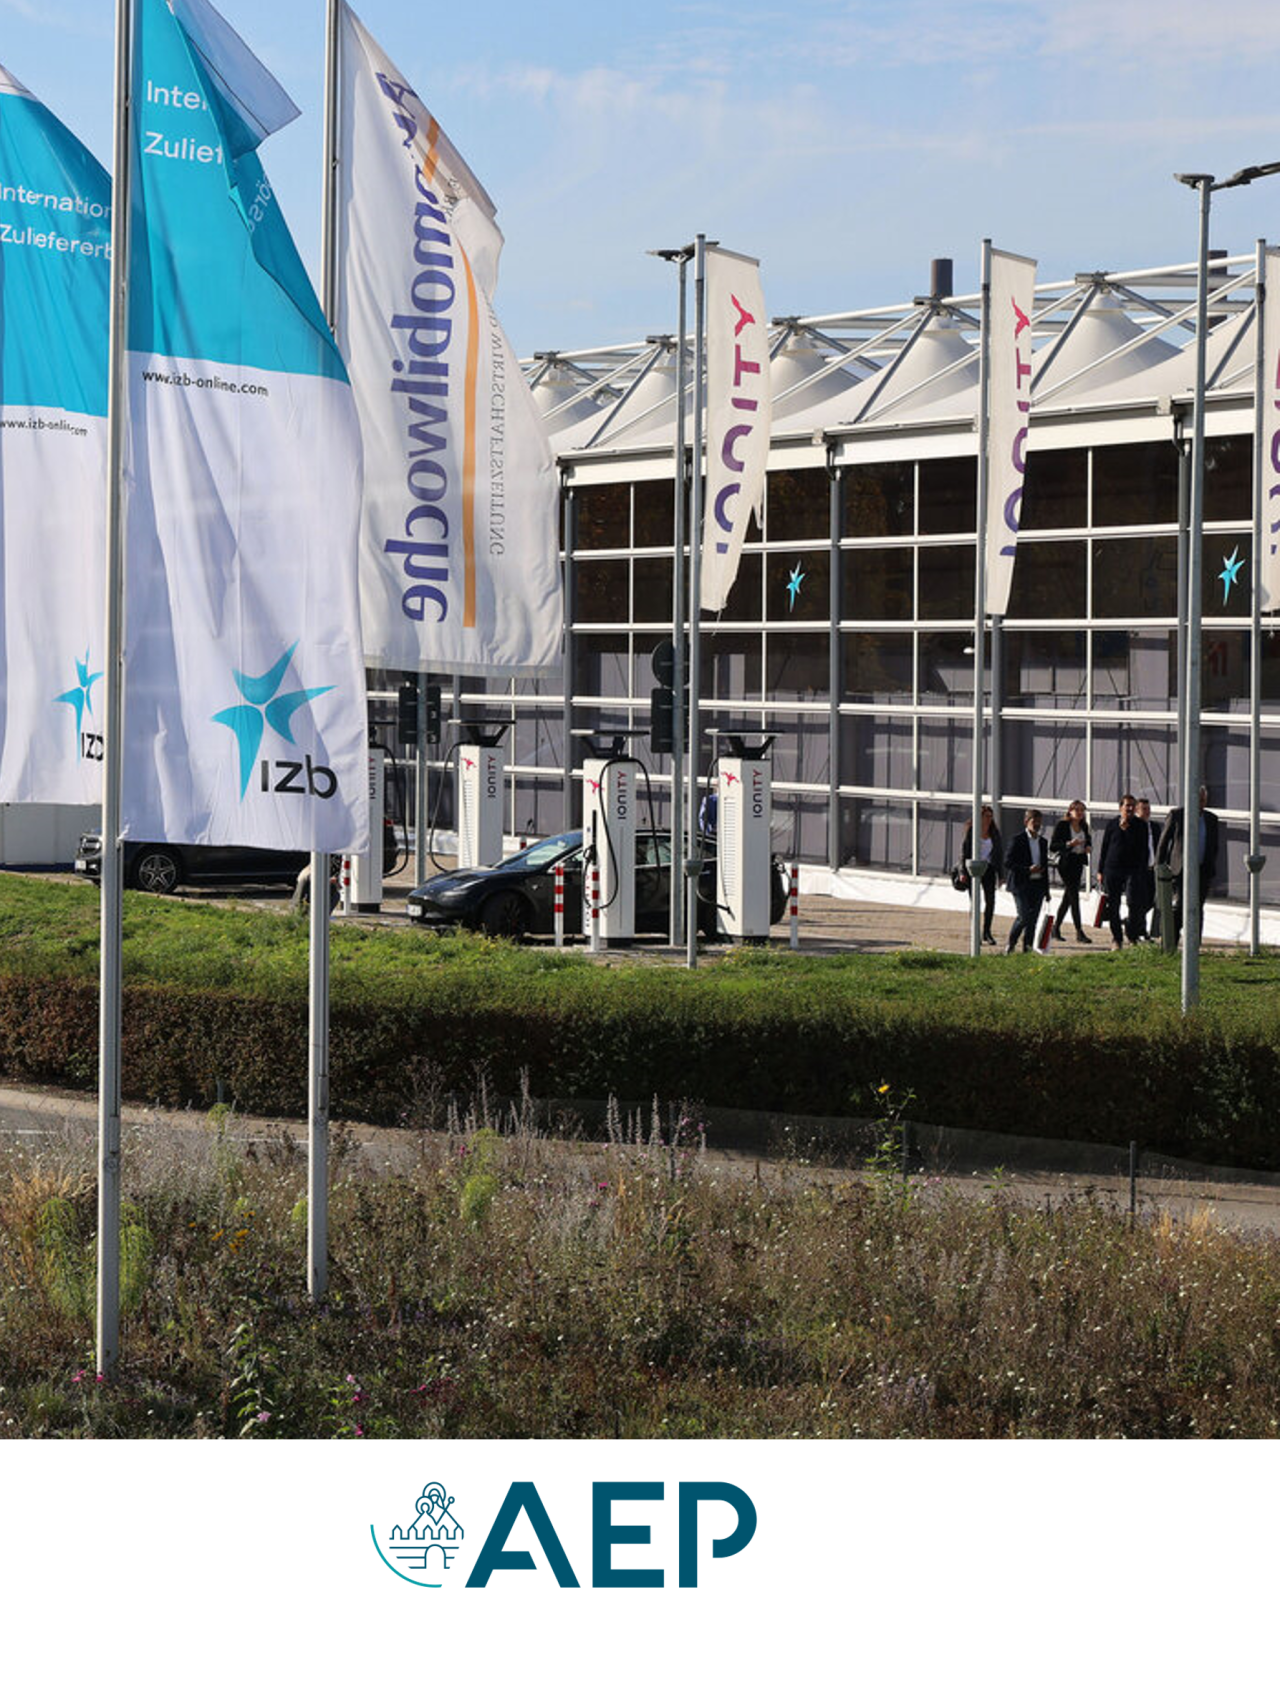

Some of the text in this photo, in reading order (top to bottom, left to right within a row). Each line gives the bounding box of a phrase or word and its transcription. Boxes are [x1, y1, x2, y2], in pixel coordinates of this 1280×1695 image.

[142, 370, 269, 396] www.izb-online.com
[261, 754, 338, 799] izb
[617, 770, 627, 820] IONITY
[753, 768, 763, 818] IONITY
